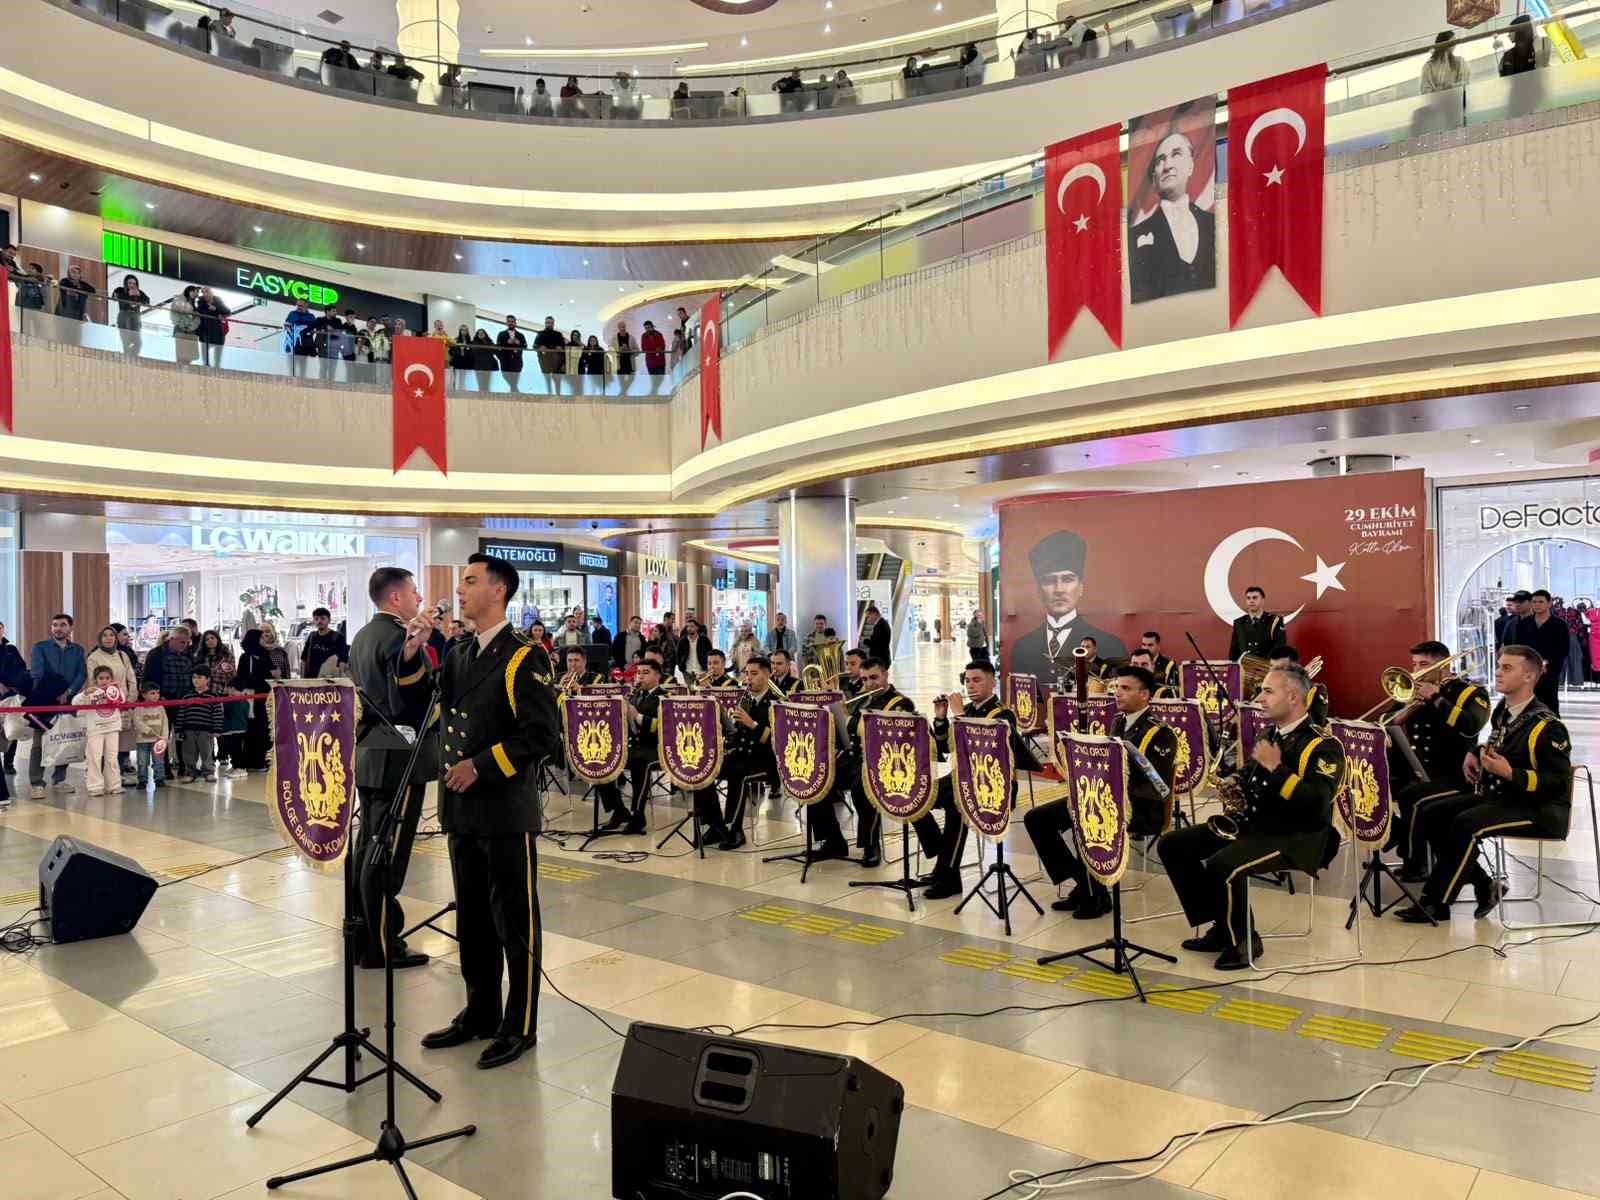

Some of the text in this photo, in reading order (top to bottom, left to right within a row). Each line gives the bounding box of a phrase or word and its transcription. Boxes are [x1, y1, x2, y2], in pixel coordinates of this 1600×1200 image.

[1344, 503, 1417, 521] 29 EKİM
[1350, 519, 1415, 530] CUMHURİYET
[1361, 528, 1403, 538] BAYRAMI
[313, 690, 342, 705] ORDU
